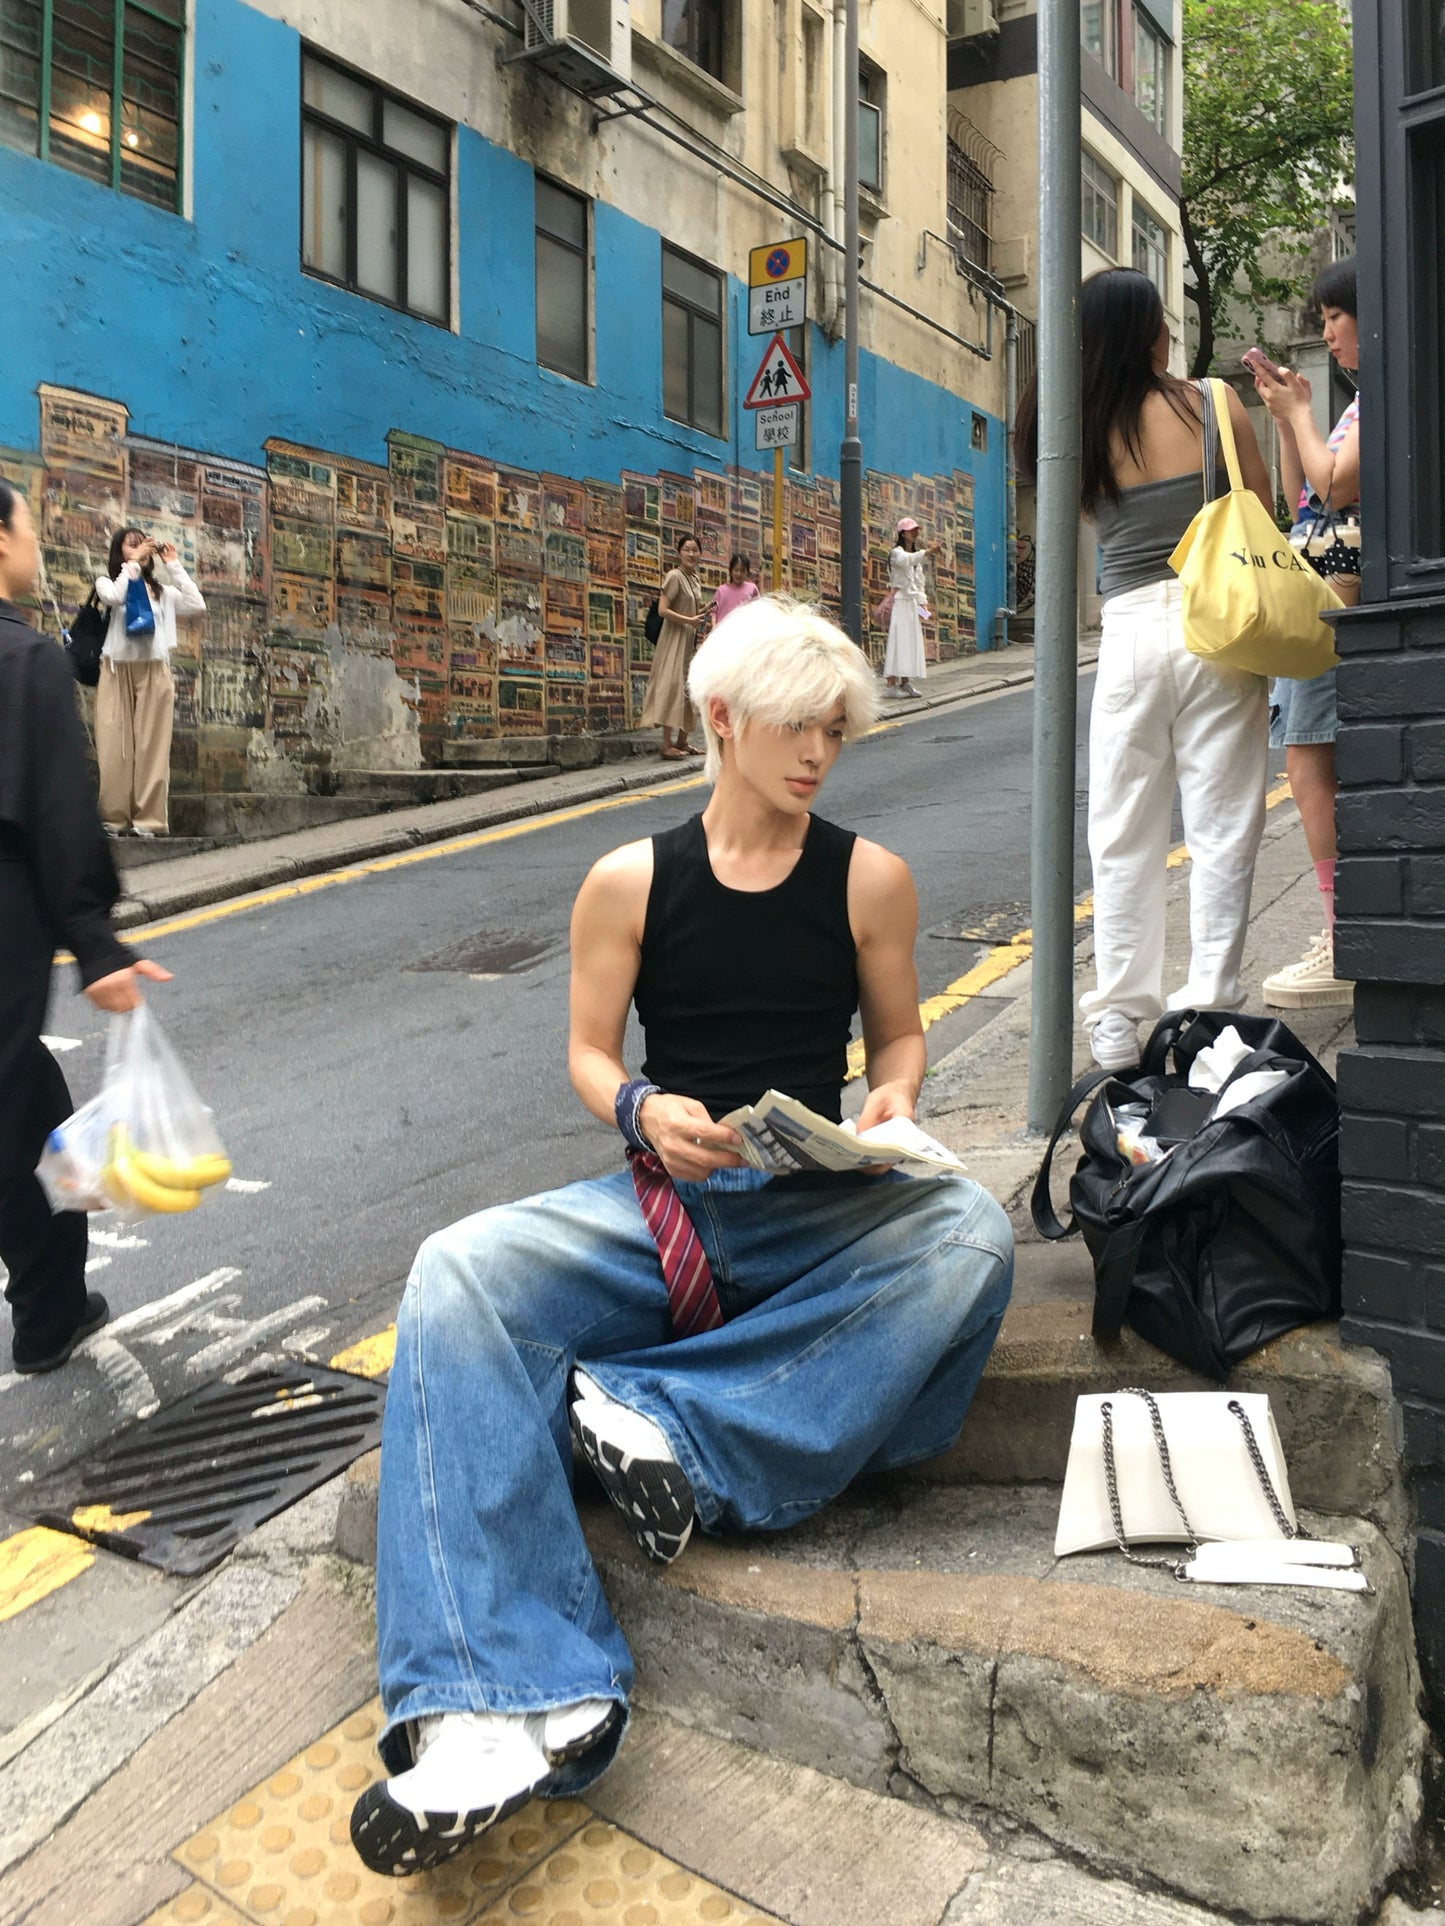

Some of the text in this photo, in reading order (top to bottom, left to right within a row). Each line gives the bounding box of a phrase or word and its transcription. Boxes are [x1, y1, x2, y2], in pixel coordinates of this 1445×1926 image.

[765, 286, 790, 303] End
[760, 304, 794, 327] 終止
[760, 410, 793, 425] School
[763, 425, 790, 443] 學校
[1272, 550, 1310, 572] CA
